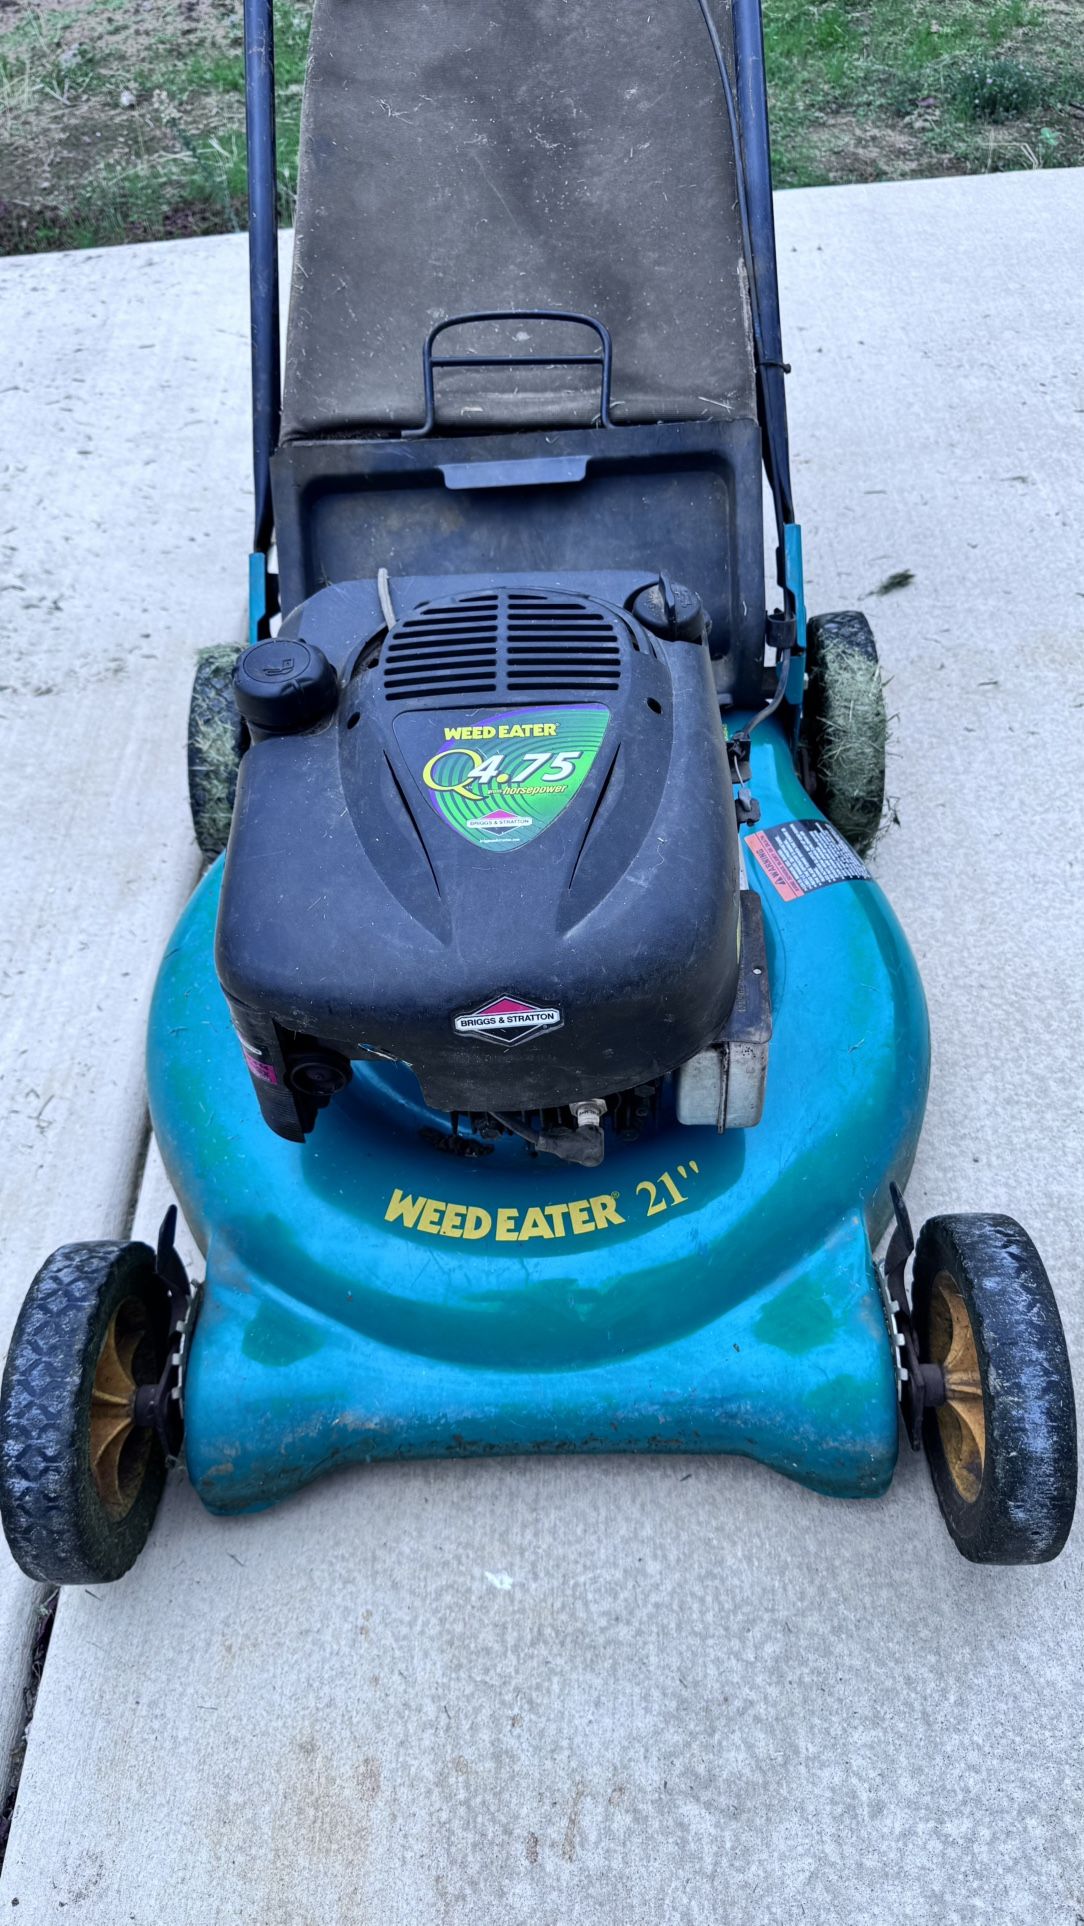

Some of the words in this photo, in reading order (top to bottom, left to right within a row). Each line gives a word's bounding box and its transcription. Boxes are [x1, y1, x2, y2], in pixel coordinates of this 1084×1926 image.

[444, 726, 496, 741] WEED
[498, 723, 558, 739] EATER
[502, 784, 568, 796] horsepower
[460, 1017, 497, 1027] BRIGGS
[498, 1016, 505, 1024] &
[506, 1012, 554, 1023] STRATTON
[384, 1188, 492, 1240] WEED
[495, 1193, 626, 1241] EATER
